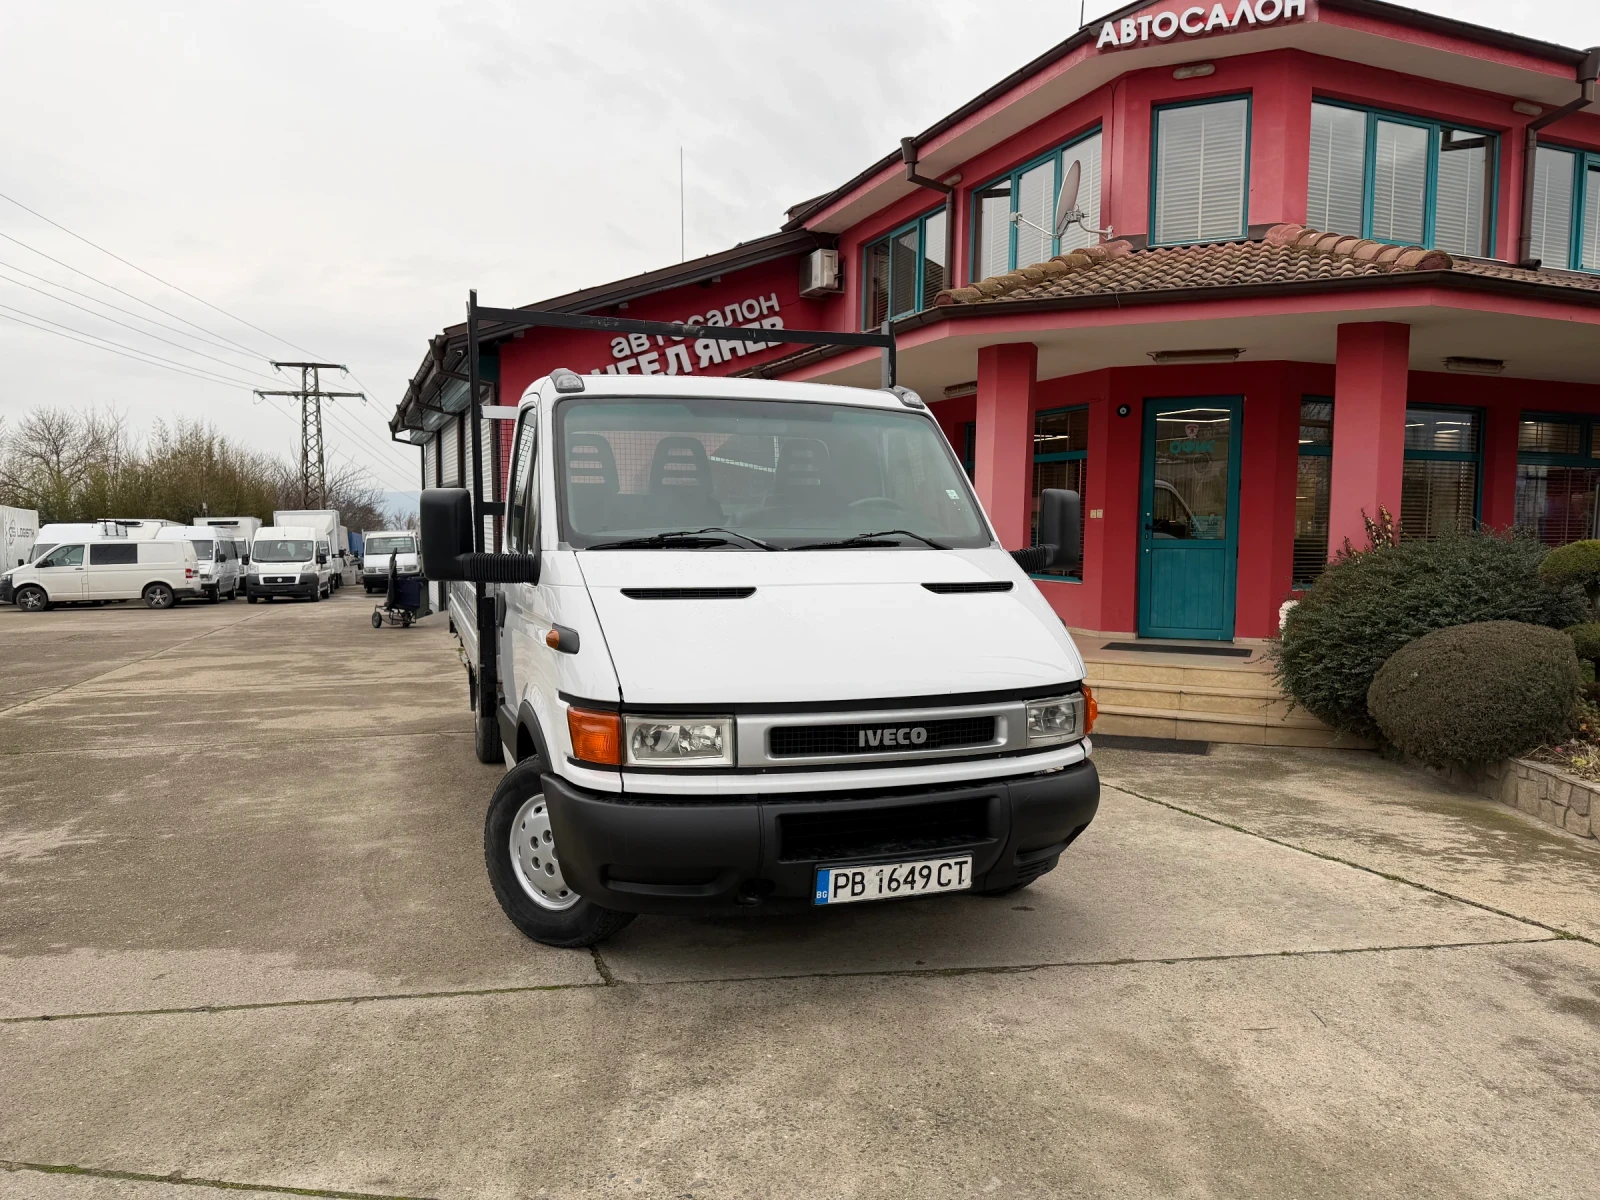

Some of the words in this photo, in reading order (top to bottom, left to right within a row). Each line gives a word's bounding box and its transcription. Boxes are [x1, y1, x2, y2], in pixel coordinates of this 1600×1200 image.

[1096, 0, 1306, 49] АВТОСАЛОН
[859, 727, 927, 747] IVECO
[833, 871, 866, 898] PB
[875, 865, 932, 894] 1649
[937, 860, 969, 887] CT
[816, 891, 828, 899] BG
